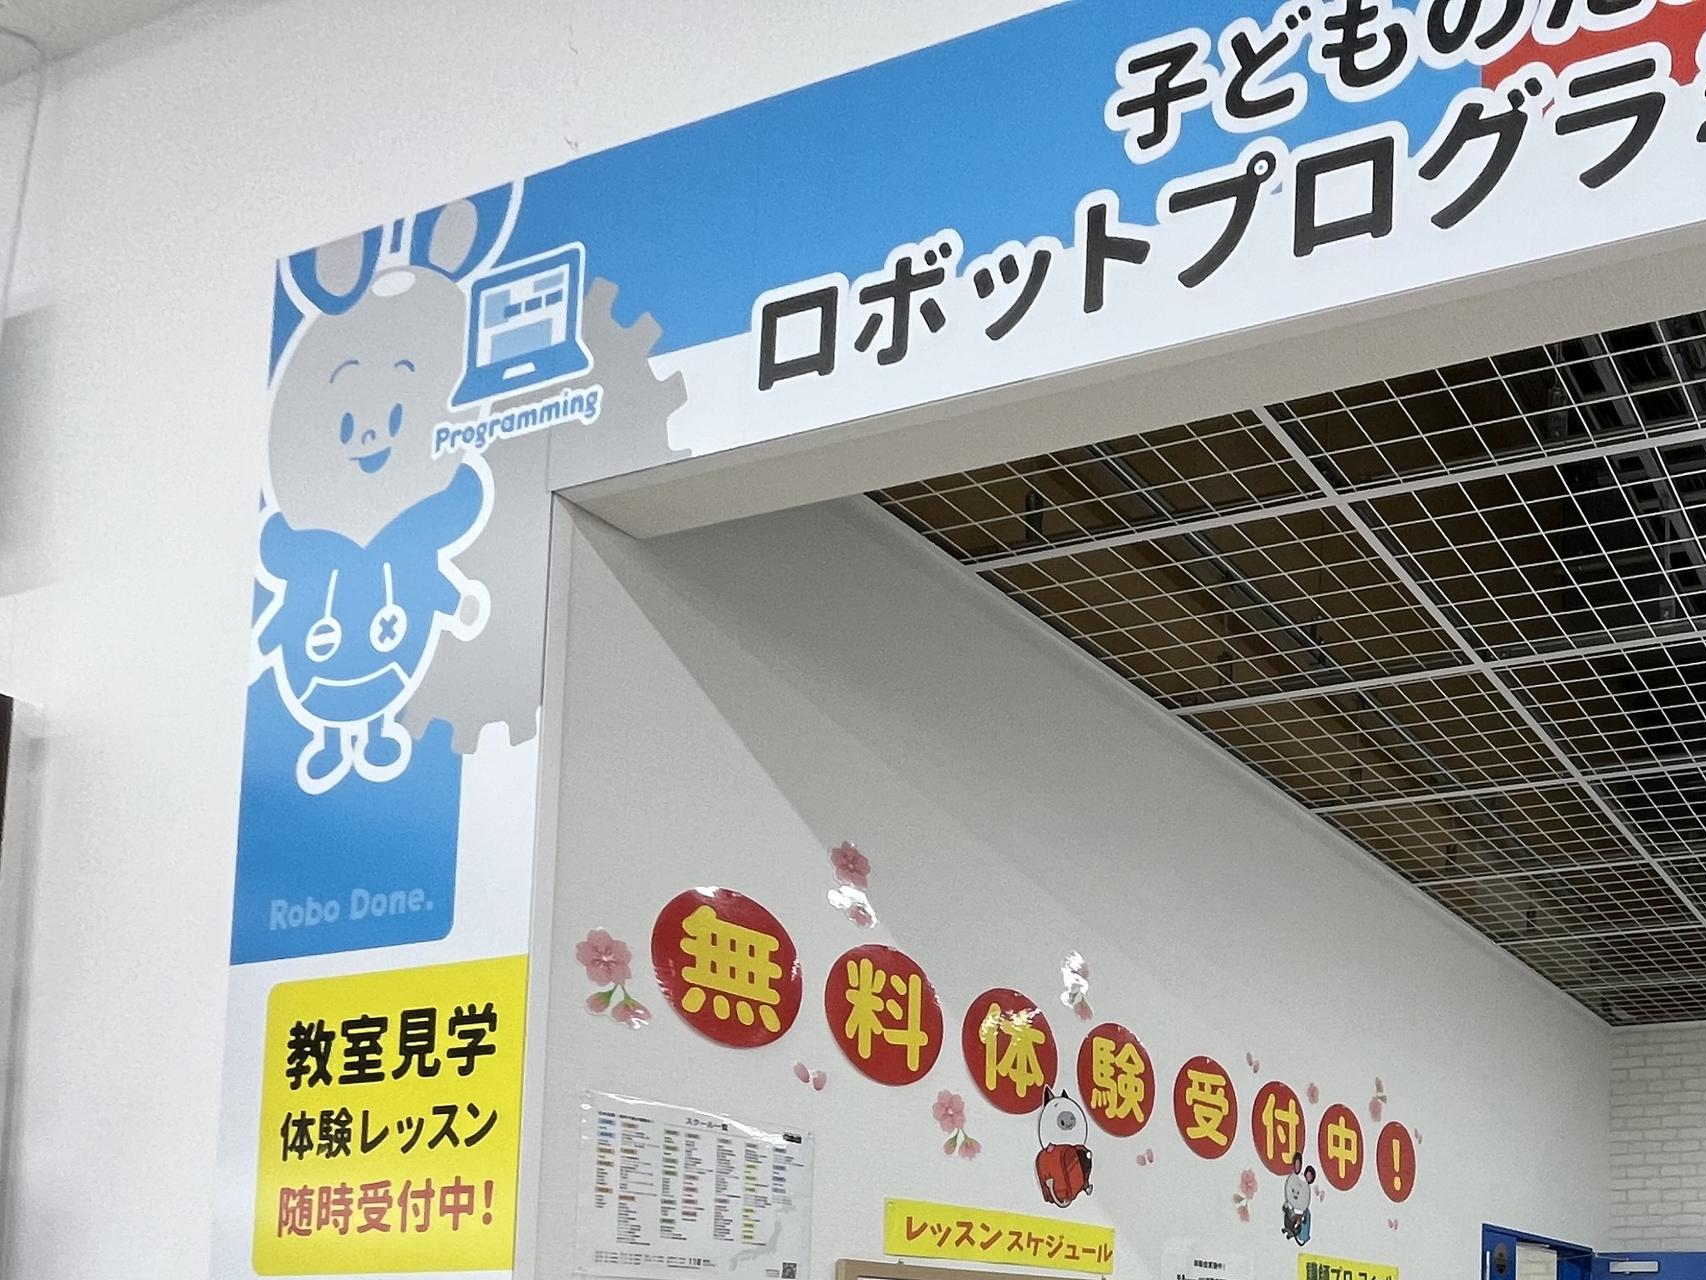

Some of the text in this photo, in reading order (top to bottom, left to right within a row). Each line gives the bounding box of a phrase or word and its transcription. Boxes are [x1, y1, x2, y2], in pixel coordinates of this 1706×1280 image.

[1116, 0, 1625, 149] 子どもの
[433, 388, 600, 453] Programming
[269, 884, 434, 931] Robo Done.
[286, 1003, 498, 1090] 教室見学
[280, 1101, 498, 1161] 体験レッスン
[277, 1176, 494, 1237] 随時受付中!
